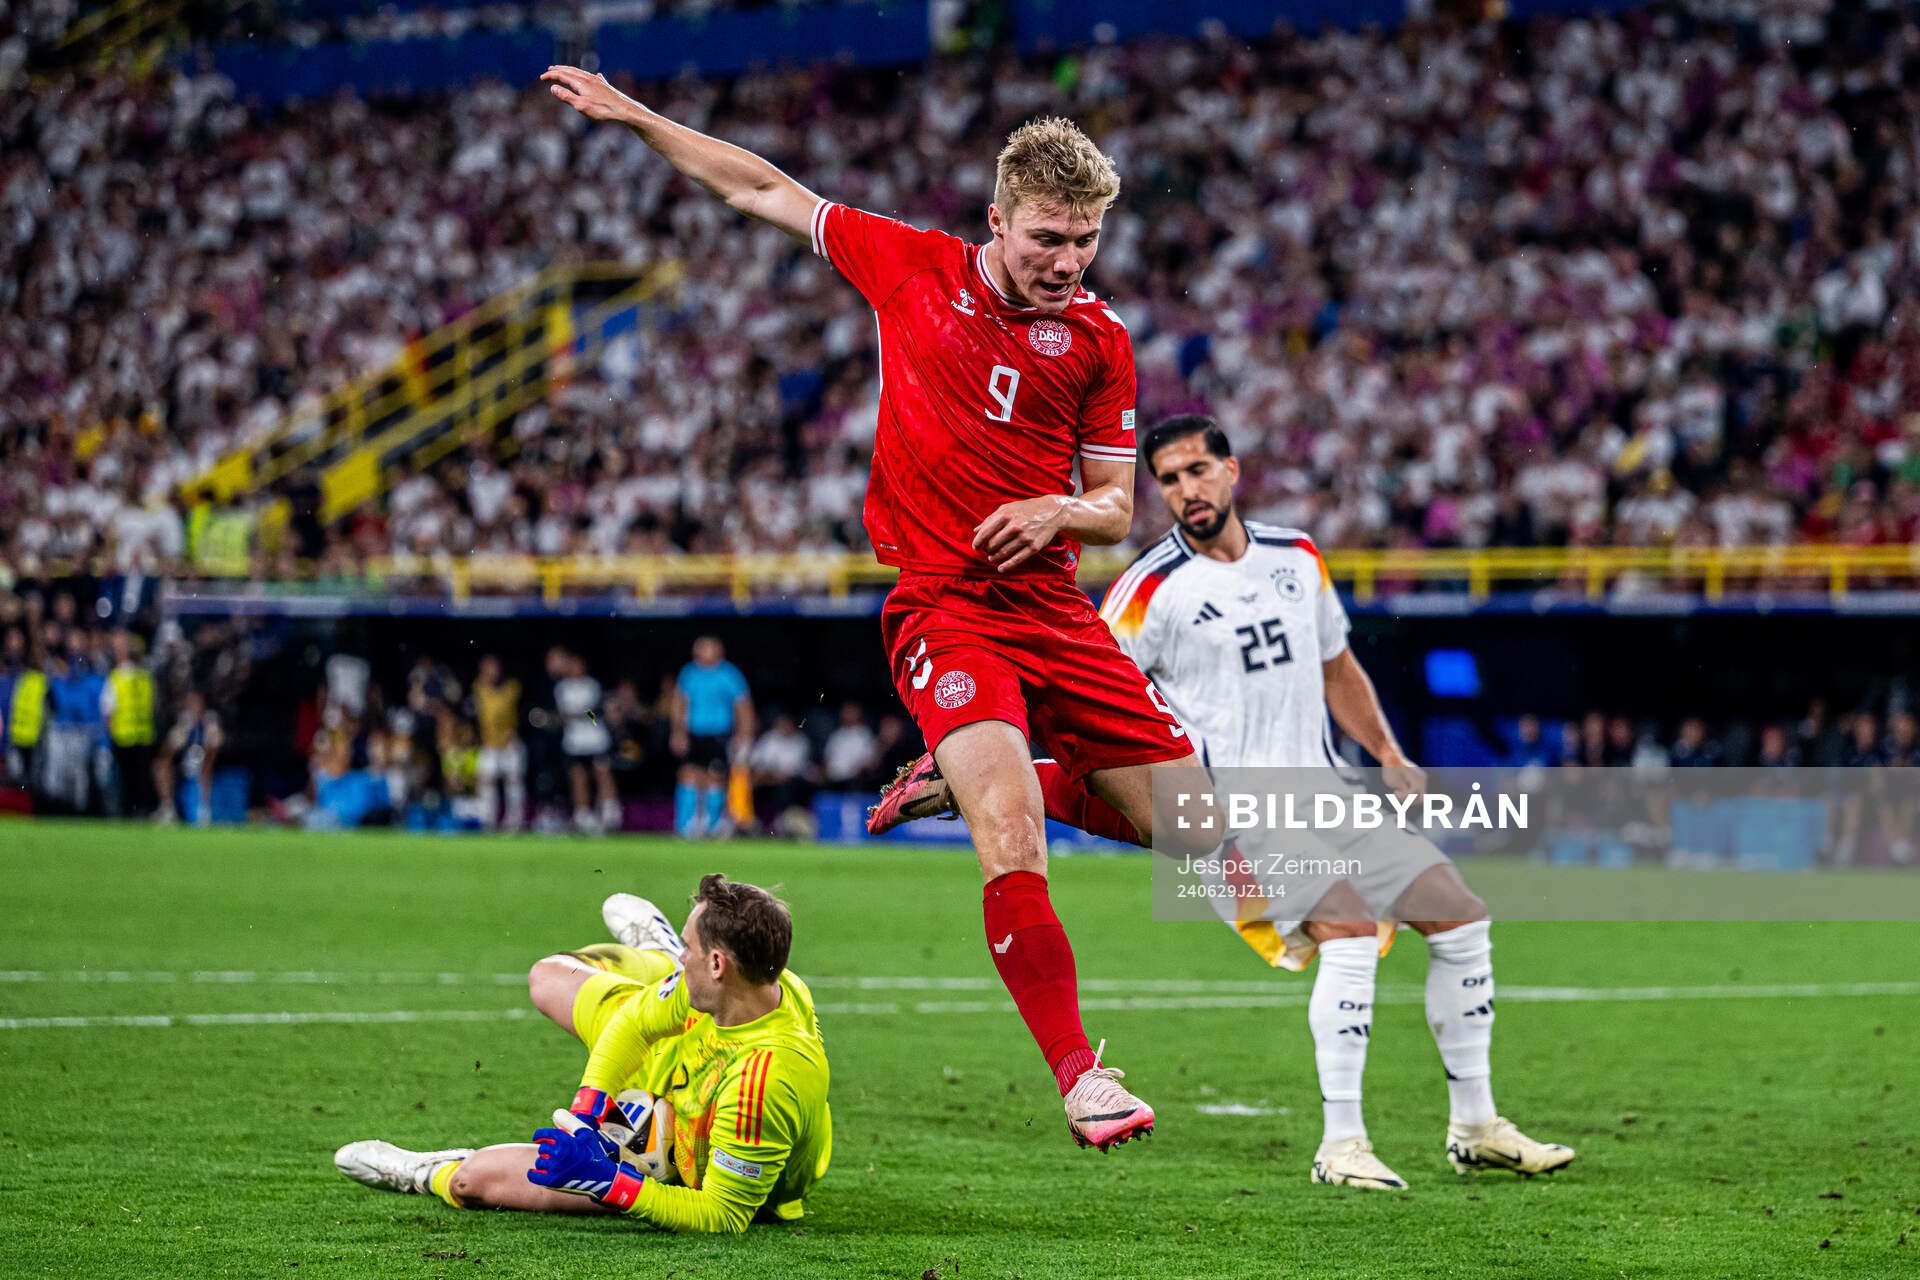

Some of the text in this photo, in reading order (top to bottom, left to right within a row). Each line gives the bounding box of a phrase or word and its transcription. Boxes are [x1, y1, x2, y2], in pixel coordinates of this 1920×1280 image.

[1038, 330, 1062, 343] DBU
[985, 365, 1020, 422] 9
[1235, 616, 1293, 674] 25
[941, 681, 967, 698] DBU
[1145, 681, 1185, 738] 9
[1462, 975, 1491, 987] DF
[1339, 1000, 1372, 1011] DF
